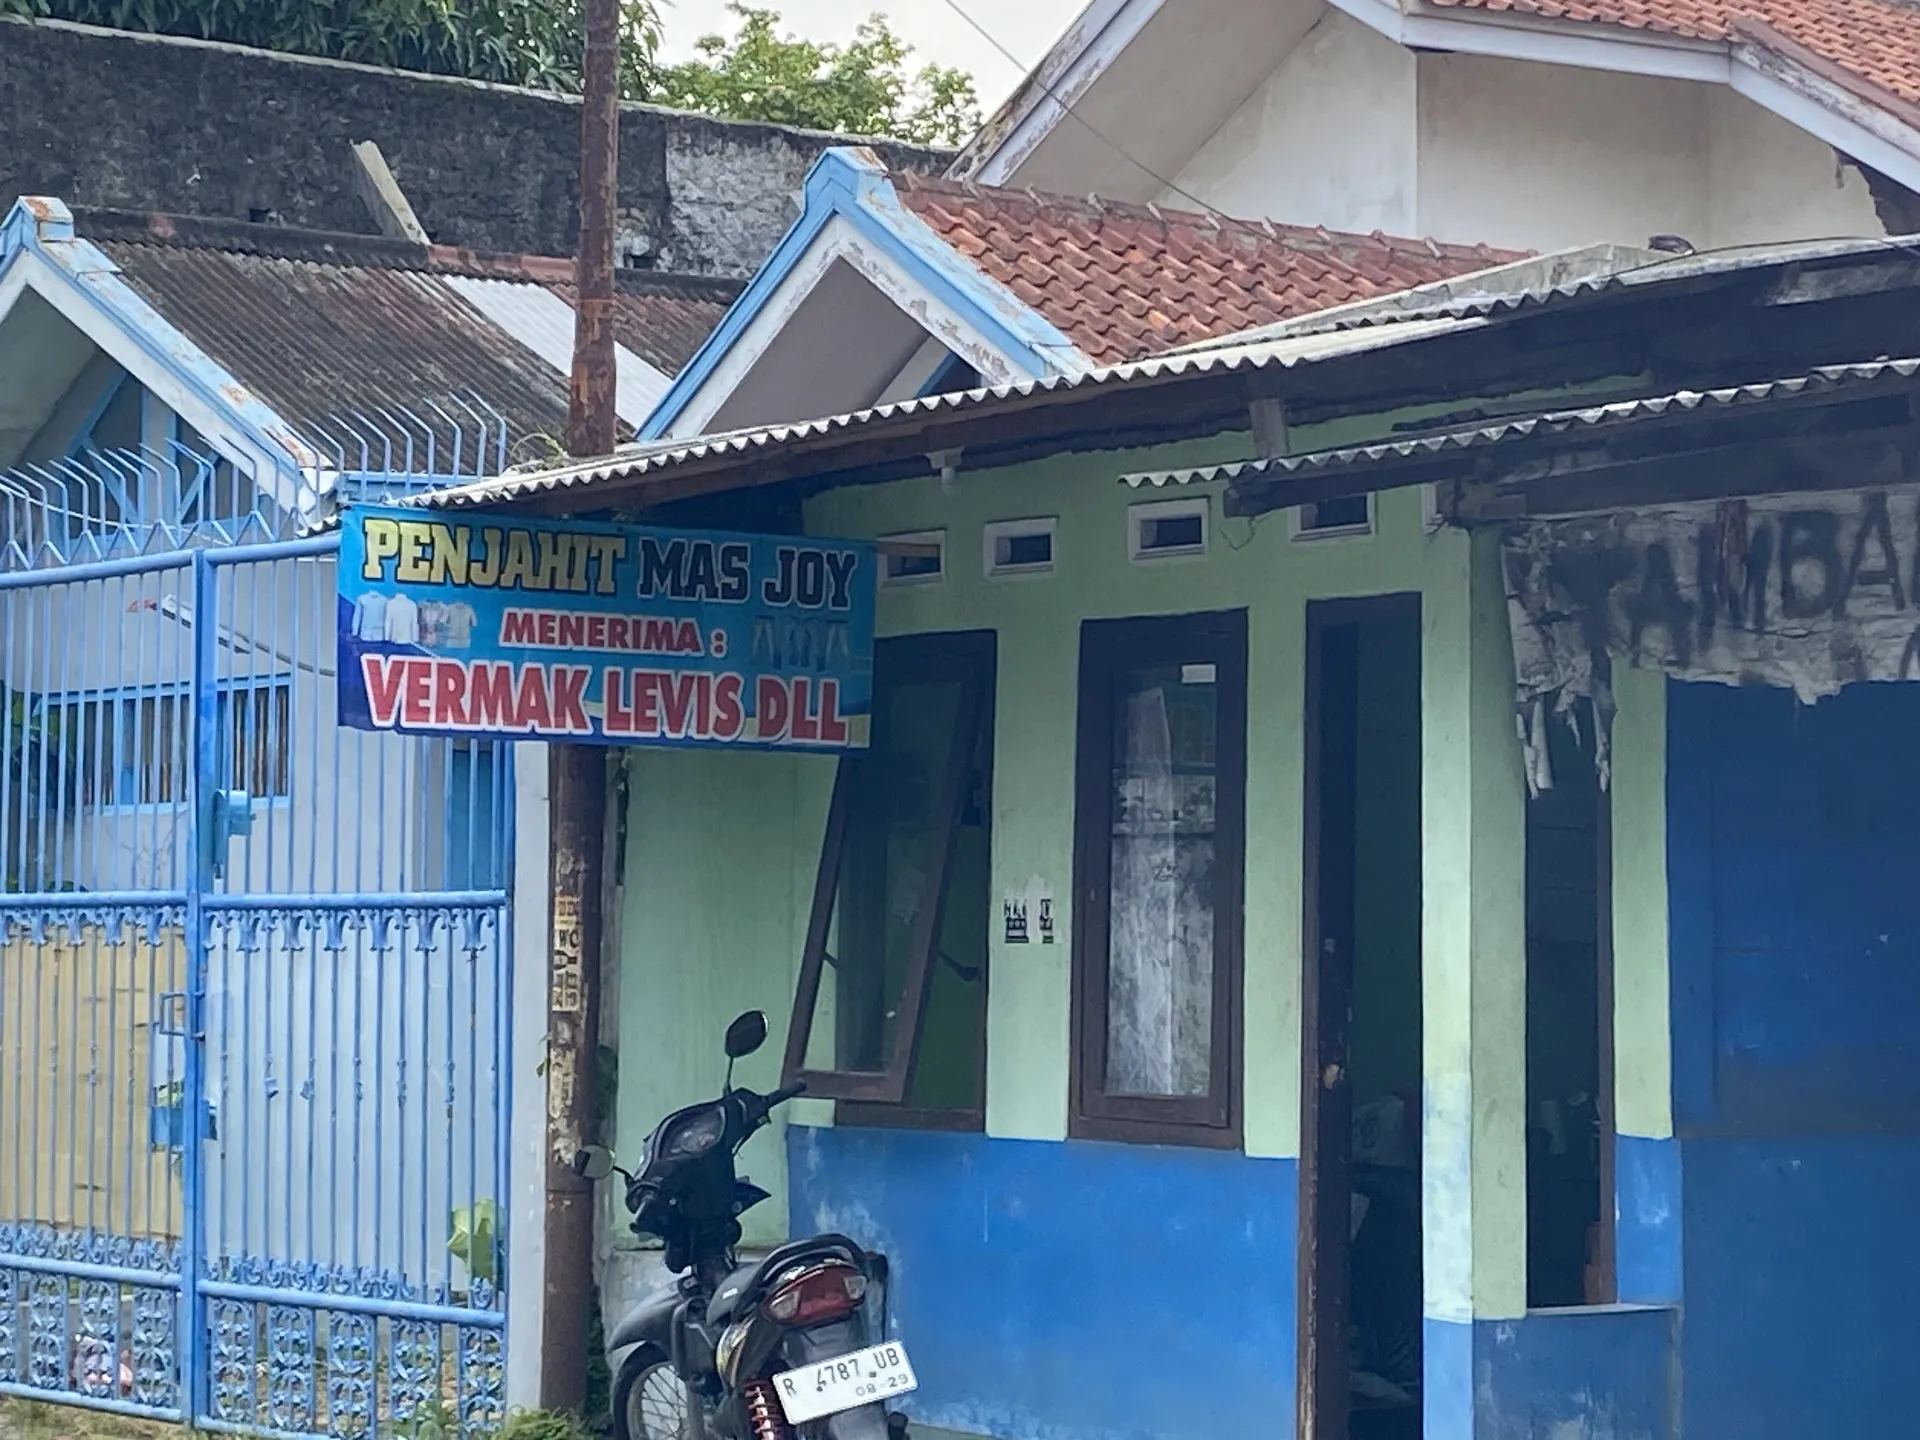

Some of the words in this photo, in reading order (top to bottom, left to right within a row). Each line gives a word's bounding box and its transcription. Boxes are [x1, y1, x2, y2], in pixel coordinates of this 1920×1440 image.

[363, 518, 625, 593] PENJAHIT
[639, 537, 750, 602] MAS
[763, 547, 857, 611] JOY
[363, 655, 593, 737] VERMAK
[602, 668, 745, 741] LEVIS
[756, 675, 848, 746] DLL
[783, 1378, 797, 1398] R
[816, 1358, 860, 1387] 4787
[873, 1348, 900, 1370] UB
